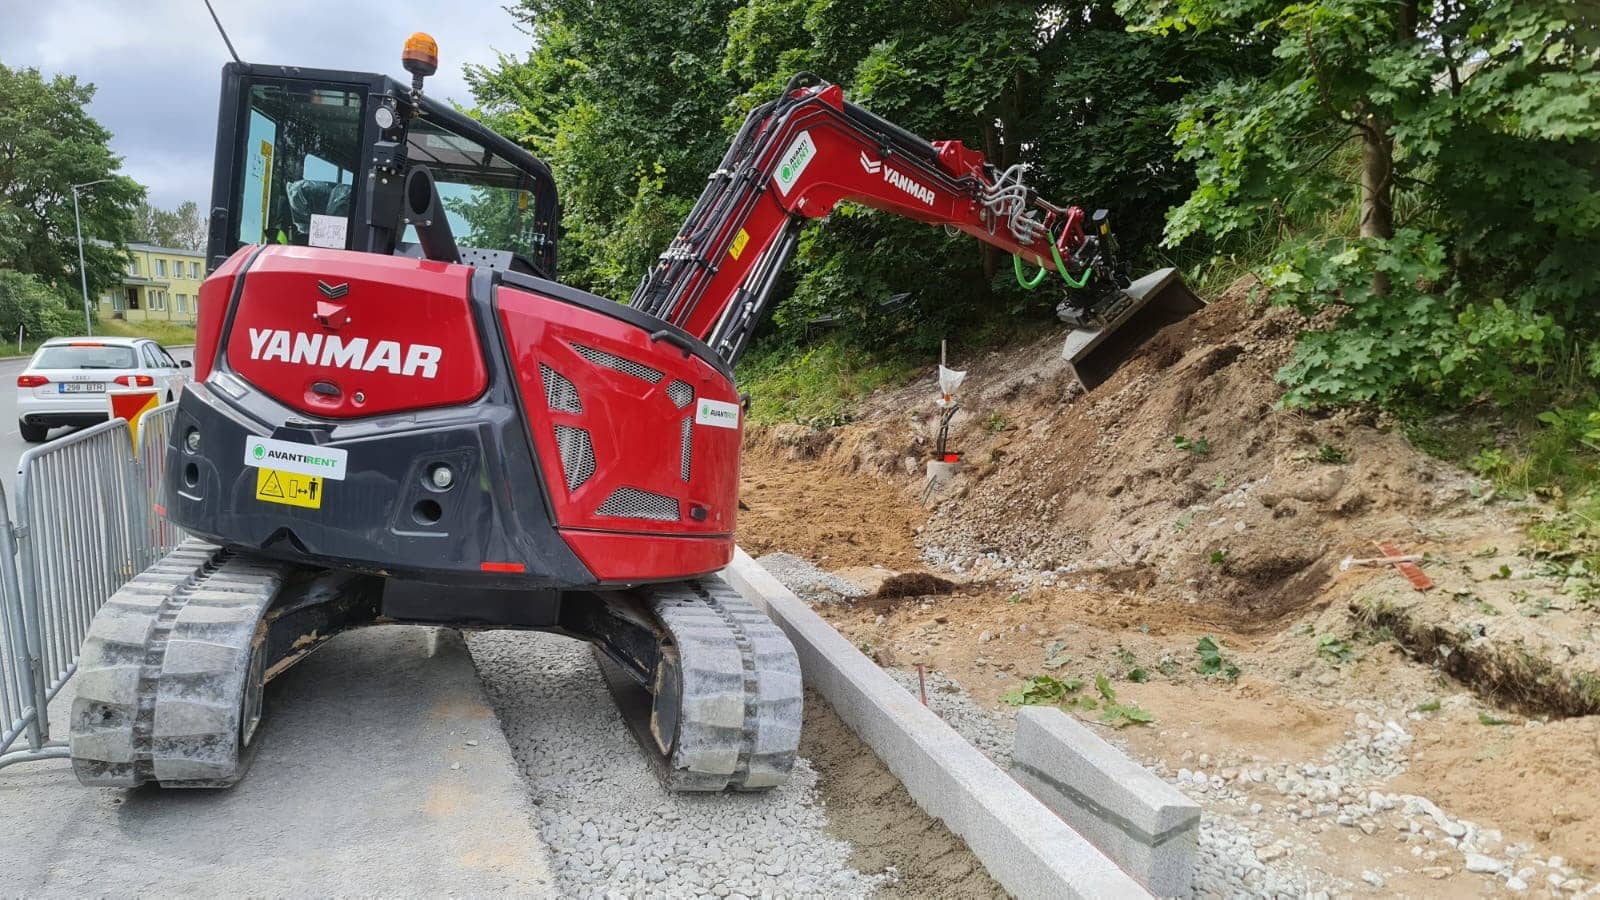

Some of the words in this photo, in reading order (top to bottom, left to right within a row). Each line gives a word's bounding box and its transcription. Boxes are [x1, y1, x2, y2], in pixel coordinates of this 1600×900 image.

[790, 139, 807, 164] AVANTI
[792, 145, 809, 171] RENT
[884, 164, 936, 206] YANMAR
[249, 328, 442, 379] YANMAR
[268, 450, 337, 467] AVANTIRENT
